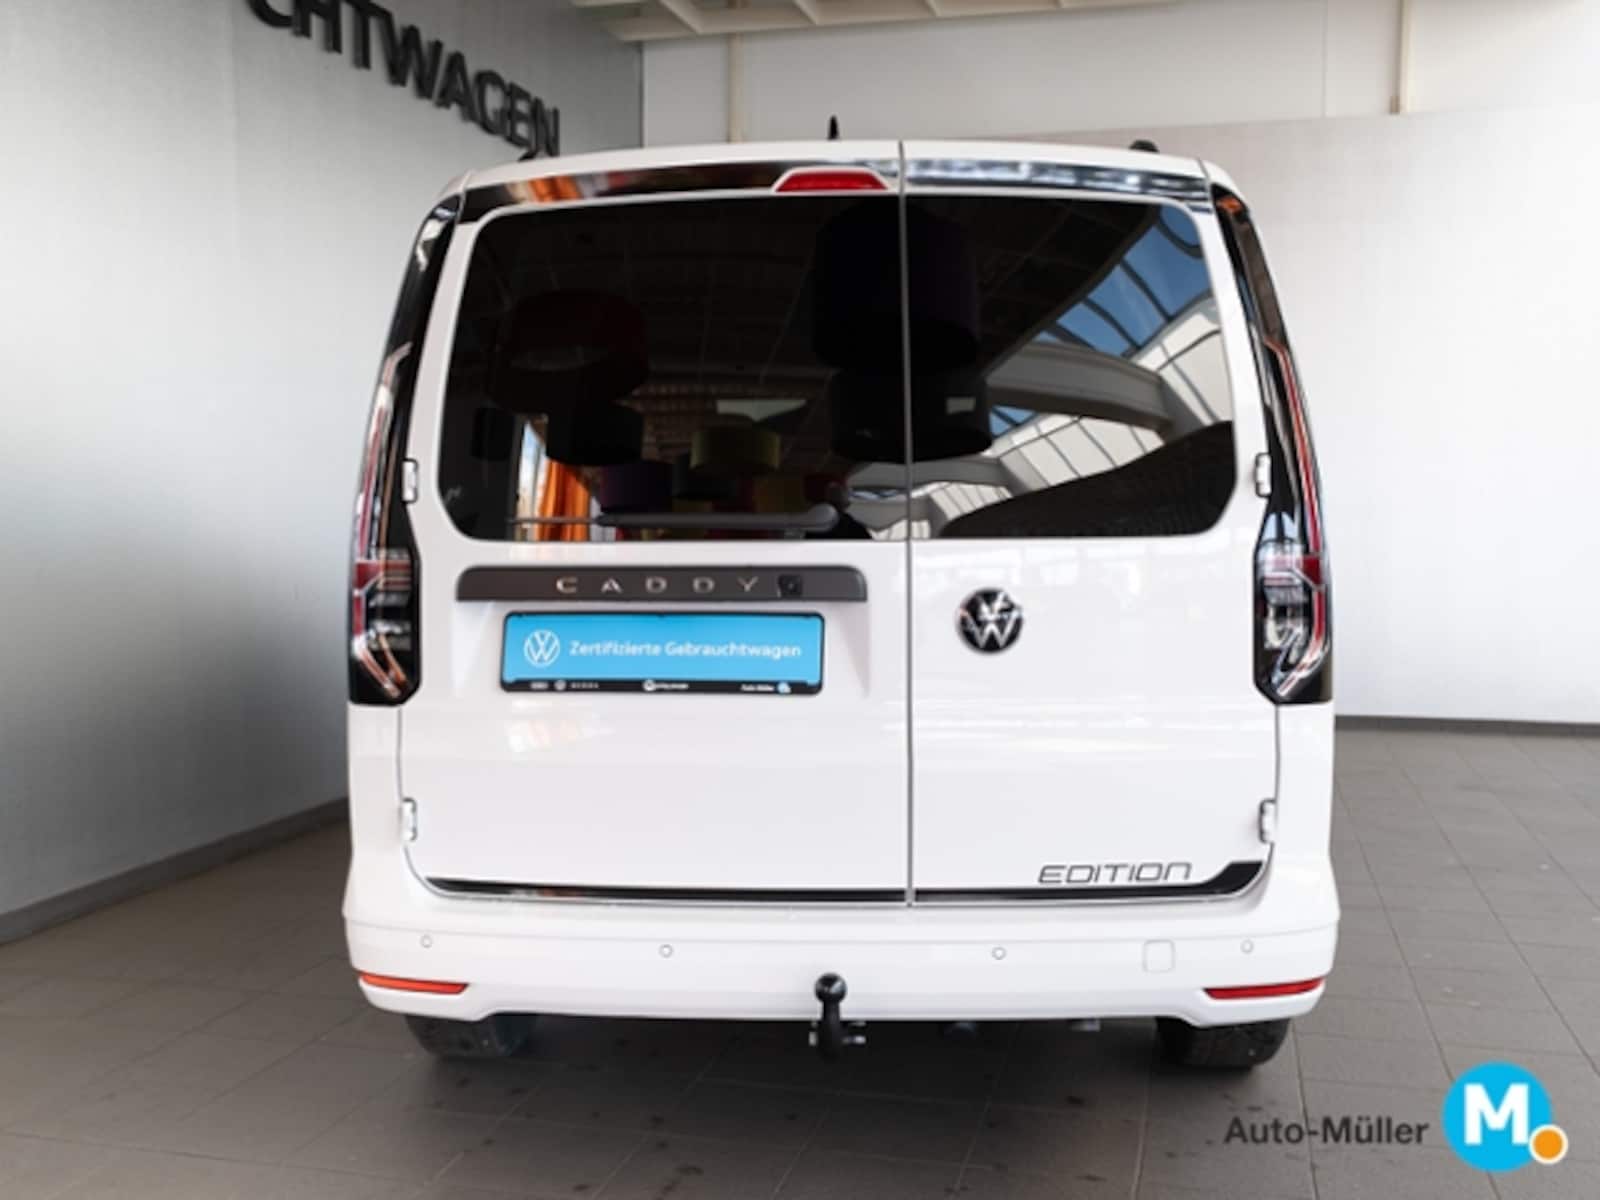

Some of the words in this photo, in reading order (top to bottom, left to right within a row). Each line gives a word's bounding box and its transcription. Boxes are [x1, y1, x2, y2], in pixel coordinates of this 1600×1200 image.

[556, 576, 759, 594] CADDY
[955, 588, 1023, 653] VW
[524, 630, 560, 667] VW
[569, 641, 660, 656] Zertifizierte
[665, 641, 802, 660] Gebrauchtwagen
[1038, 862, 1192, 883] EDITION
